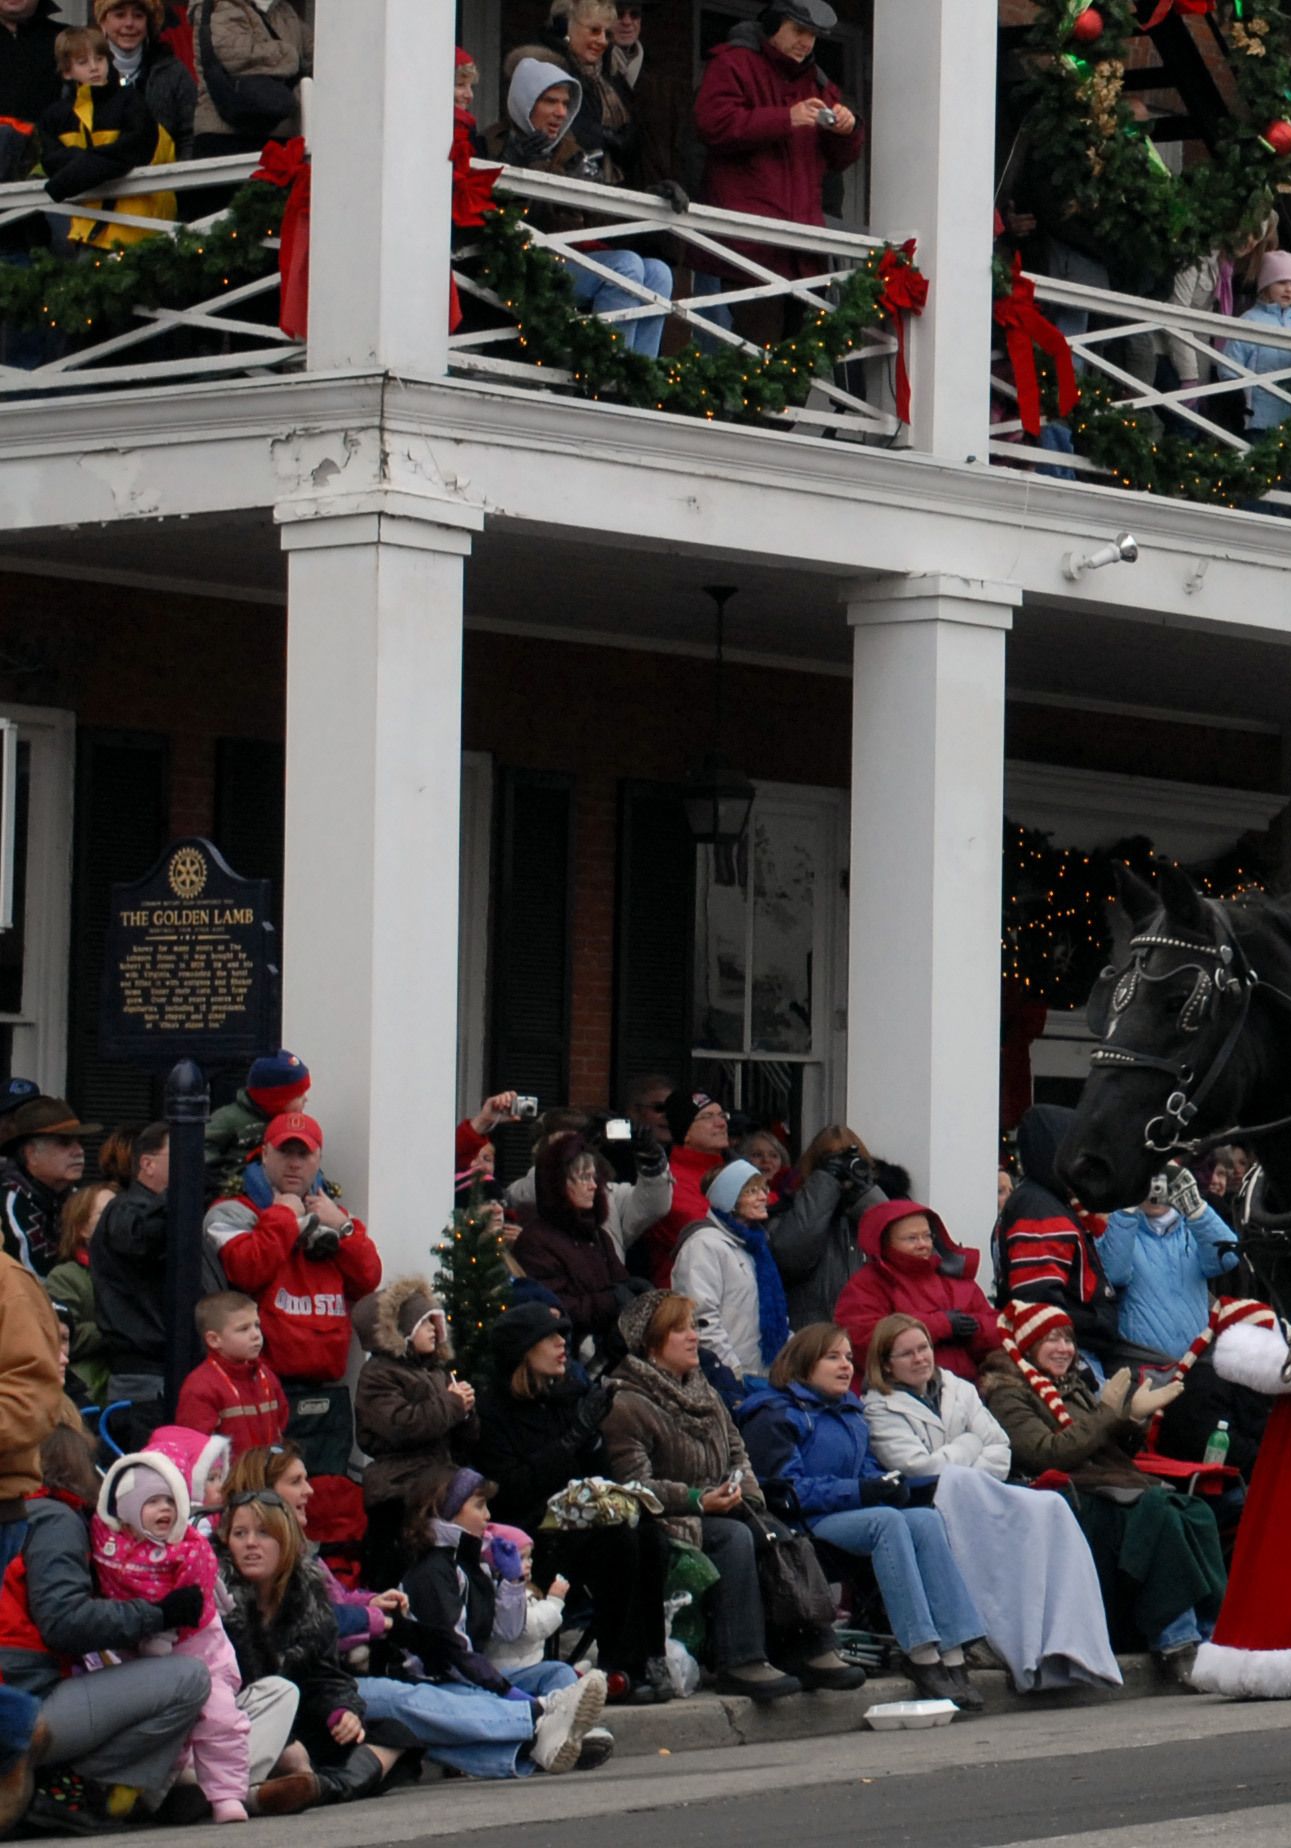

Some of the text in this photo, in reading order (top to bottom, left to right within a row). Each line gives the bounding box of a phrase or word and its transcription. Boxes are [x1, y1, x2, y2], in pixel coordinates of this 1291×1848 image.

[120, 908, 254, 927] THE GOLDEN LAMB
